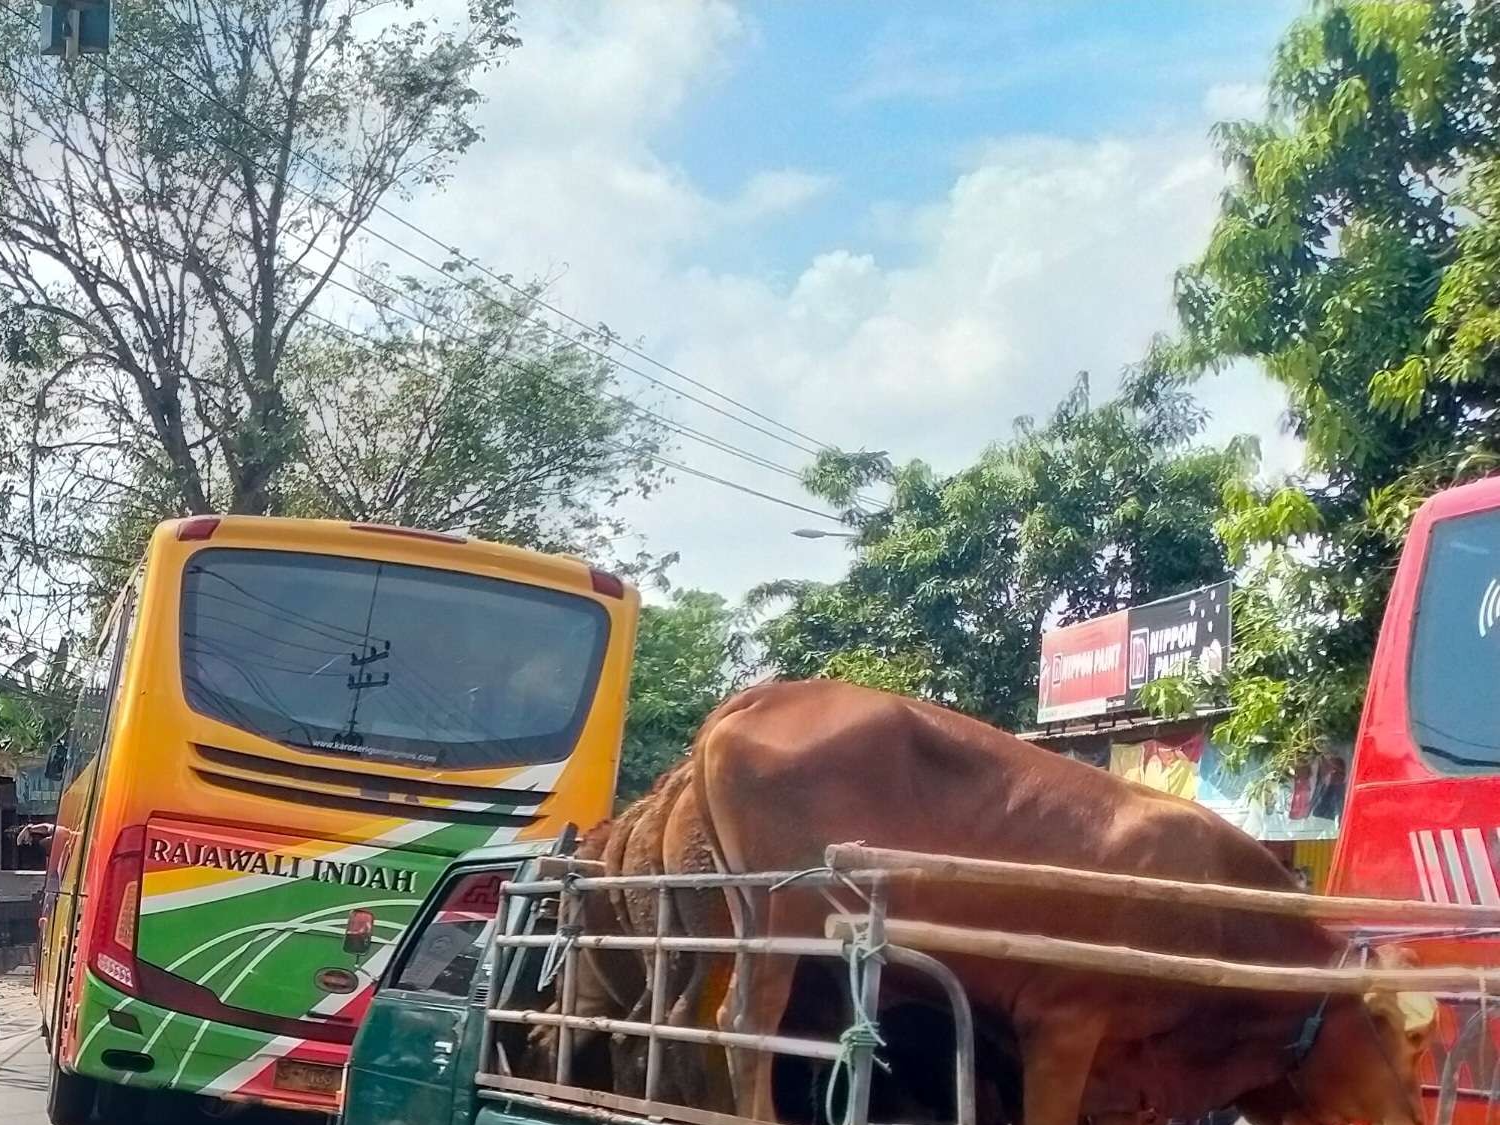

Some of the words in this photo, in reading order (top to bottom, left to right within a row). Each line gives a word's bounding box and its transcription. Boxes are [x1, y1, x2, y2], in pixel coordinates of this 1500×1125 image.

[1149, 620, 1198, 655] NIPPON
[149, 837, 302, 879] RAJAWALI
[310, 858, 418, 894] INDAH
